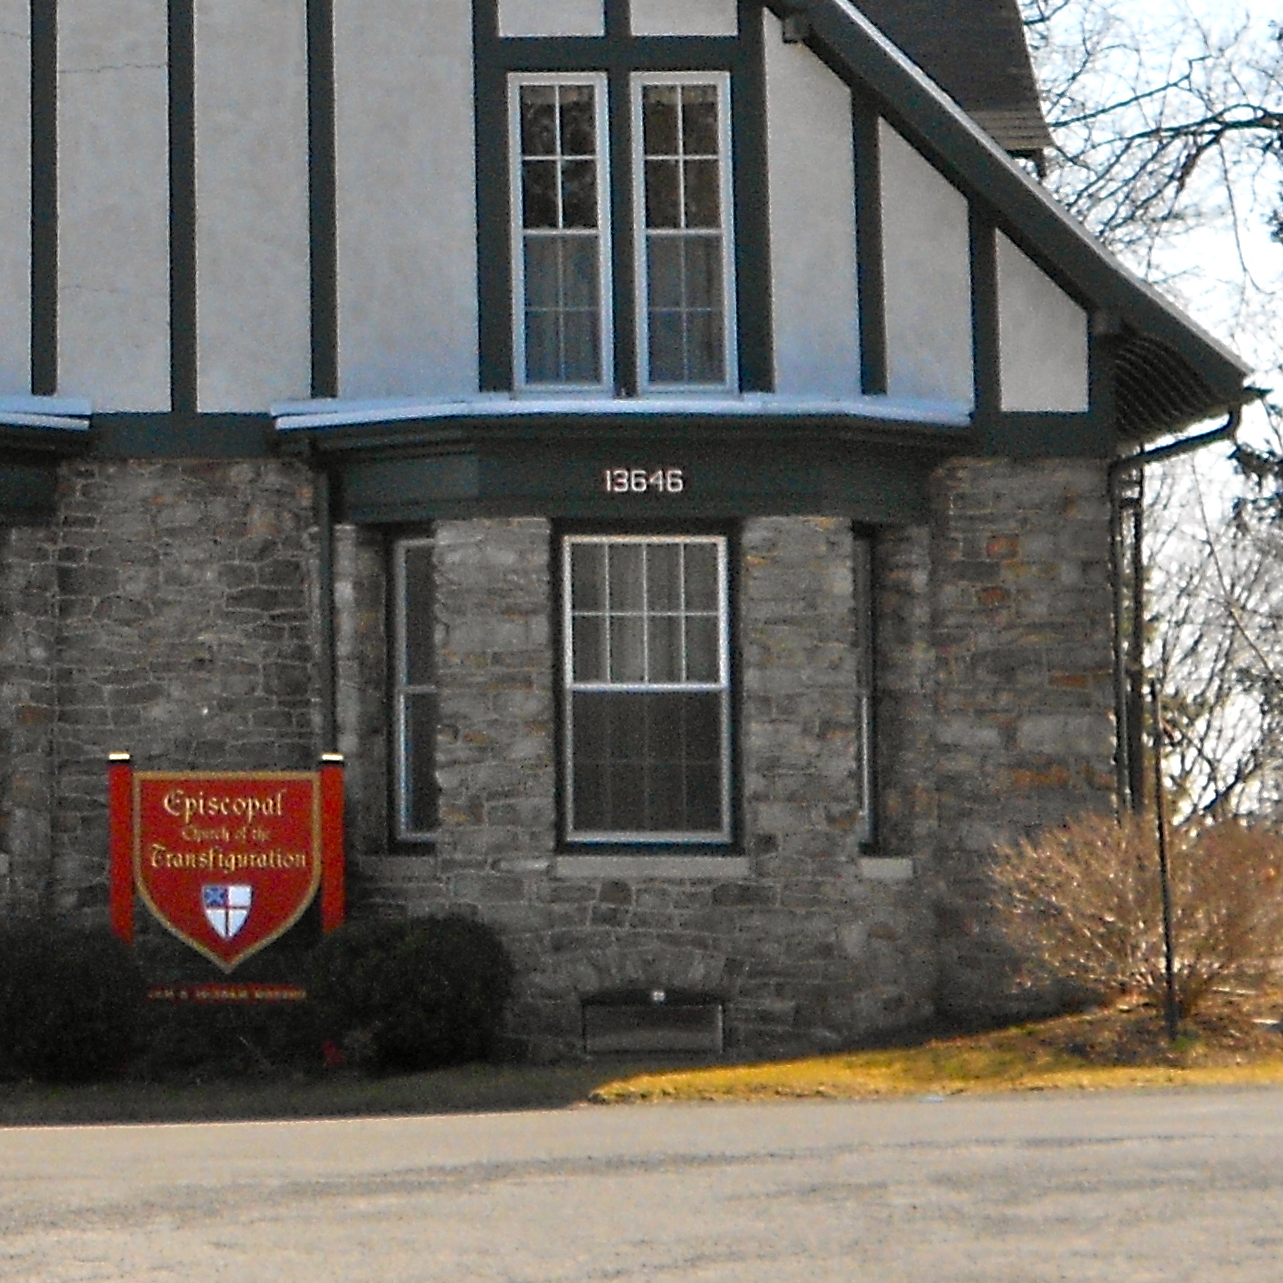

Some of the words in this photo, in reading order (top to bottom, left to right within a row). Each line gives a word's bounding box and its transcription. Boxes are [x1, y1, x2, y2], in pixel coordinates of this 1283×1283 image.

[606, 469, 684, 492] 13646
[163, 789, 287, 823] Episcopal
[182, 826, 230, 842] Church
[235, 826, 249, 842] of
[151, 843, 307, 874] Transfiguration
